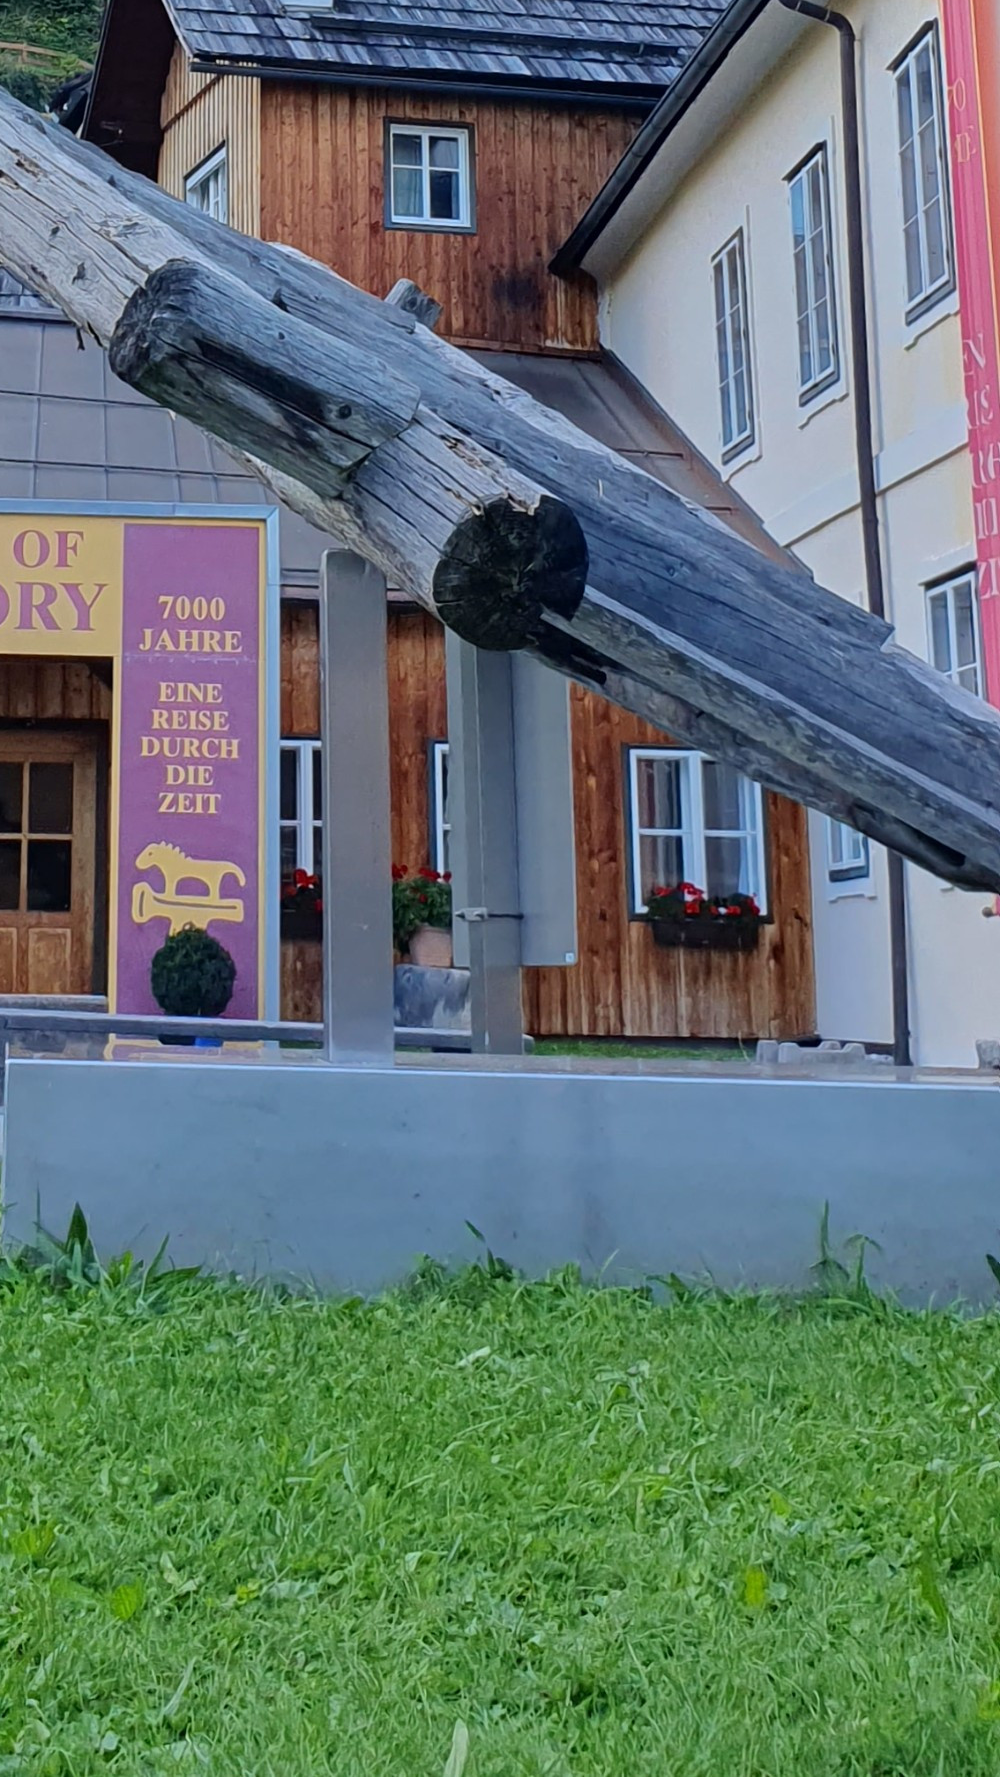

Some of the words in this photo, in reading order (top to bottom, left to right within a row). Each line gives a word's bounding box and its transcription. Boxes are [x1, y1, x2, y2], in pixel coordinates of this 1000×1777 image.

[12, 529, 85, 569] OF
[157, 594, 227, 621] 7000
[138, 627, 243, 654] JAHRE
[158, 681, 223, 704] EINE
[150, 708, 230, 732] REISE
[139, 735, 241, 760] DURCH
[165, 764, 214, 787] DIE
[157, 792, 222, 815] ZEIT
